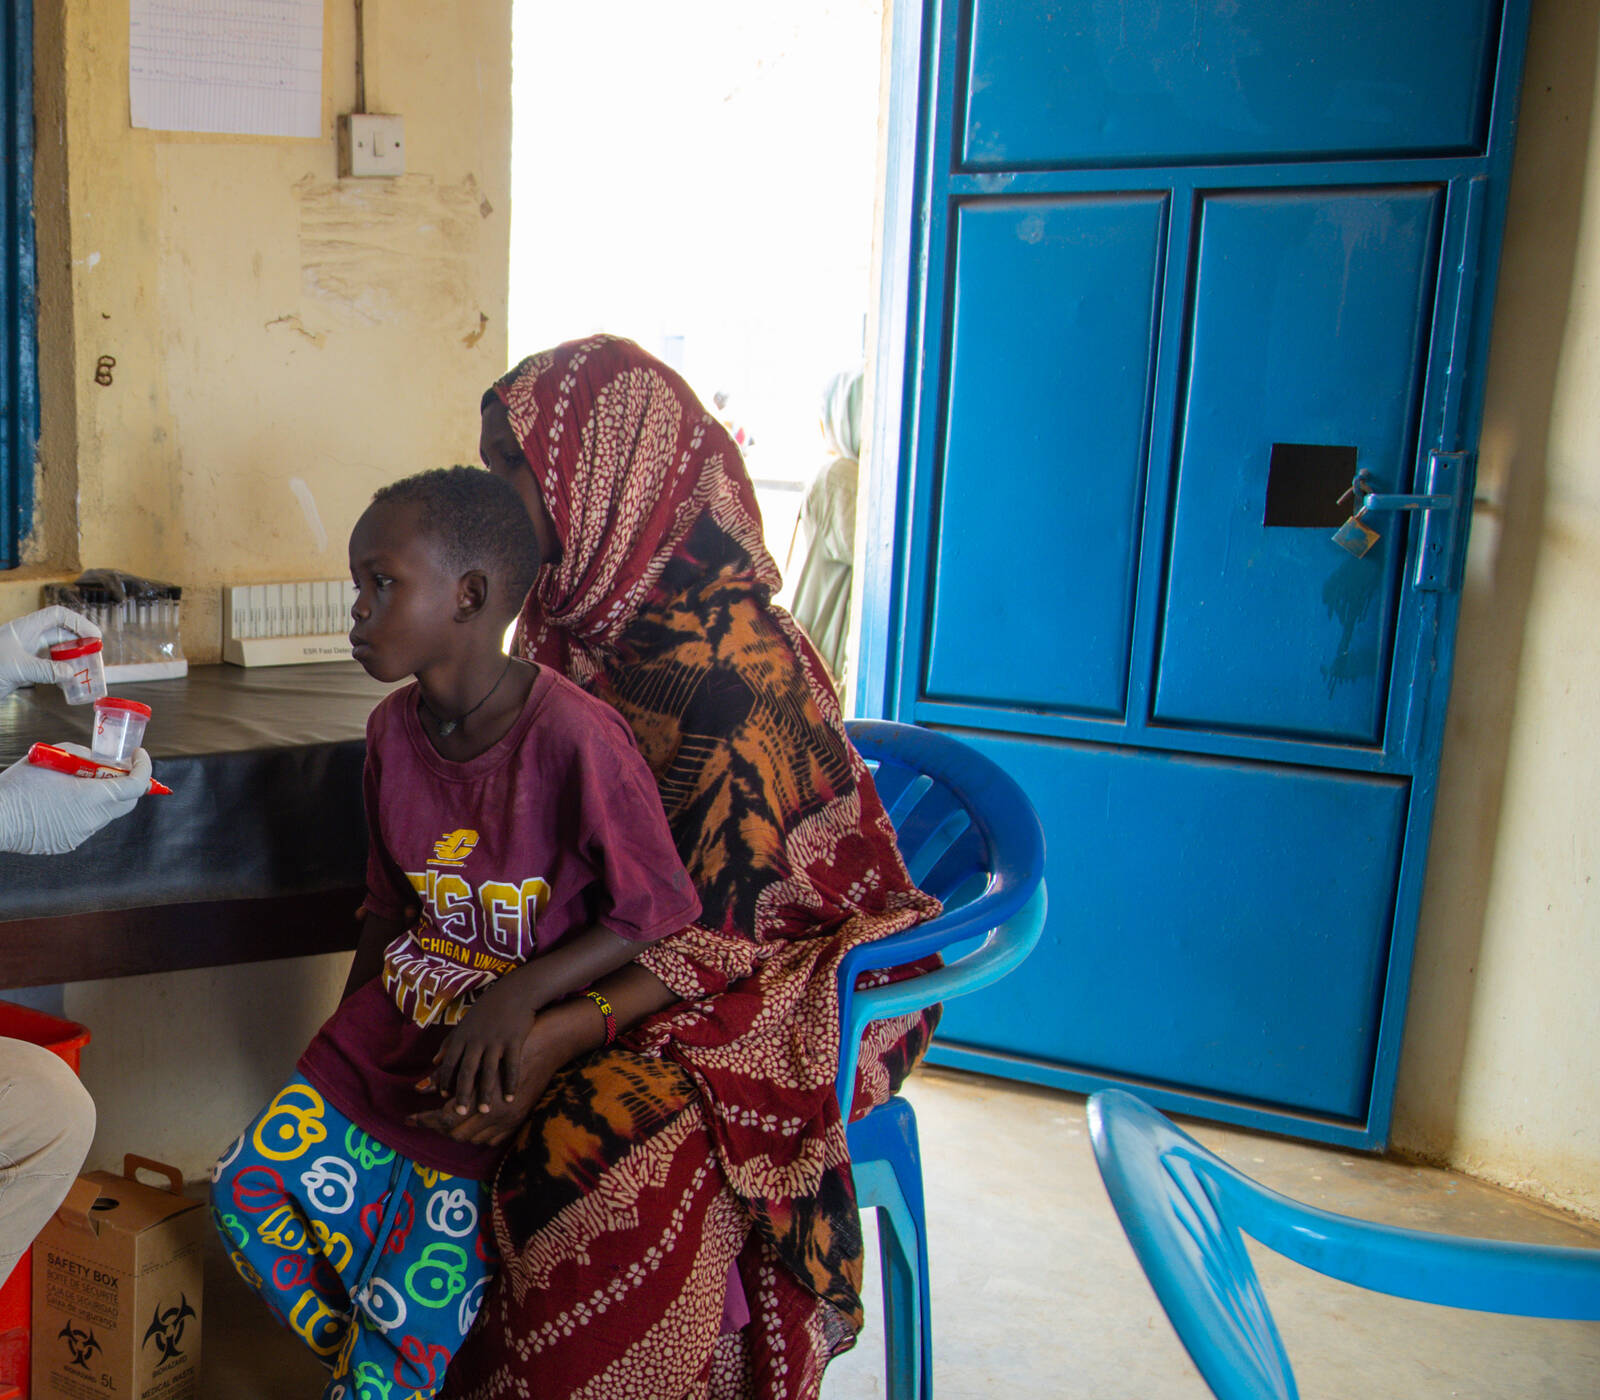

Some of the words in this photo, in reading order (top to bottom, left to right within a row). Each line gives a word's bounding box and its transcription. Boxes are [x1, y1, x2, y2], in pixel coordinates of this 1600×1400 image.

[73, 668, 92, 694] 7
[48, 1252, 90, 1277] SAFETY
[93, 1270, 118, 1289] BOX
